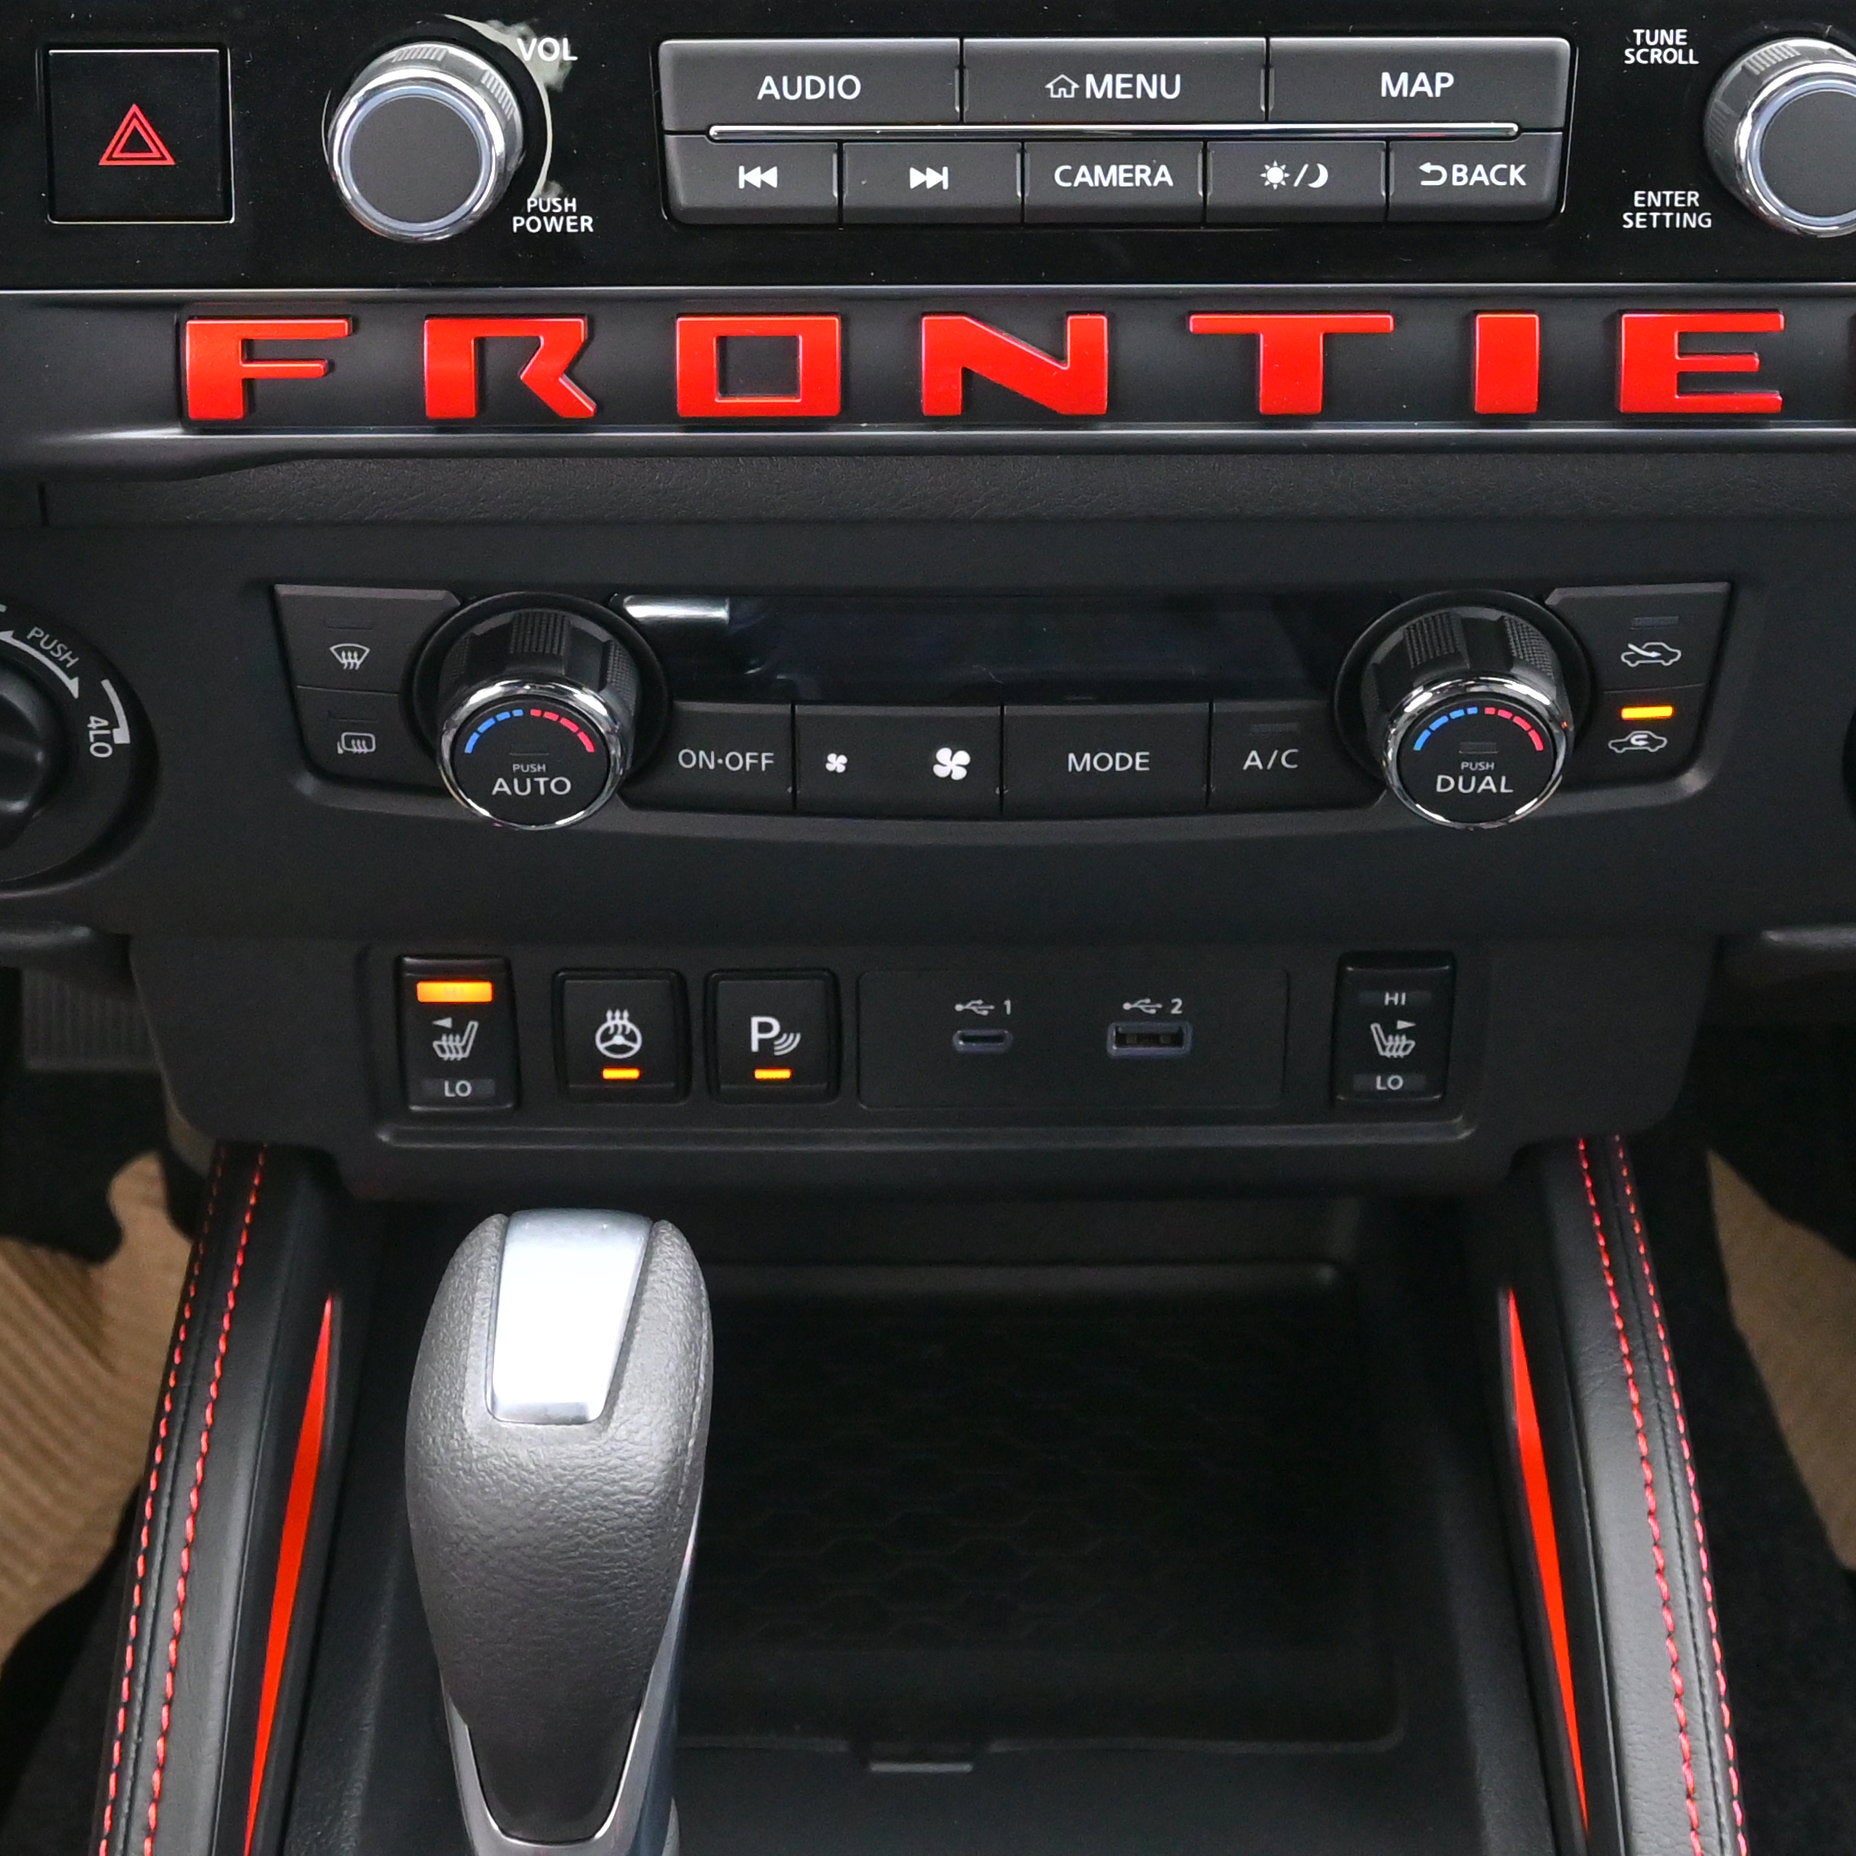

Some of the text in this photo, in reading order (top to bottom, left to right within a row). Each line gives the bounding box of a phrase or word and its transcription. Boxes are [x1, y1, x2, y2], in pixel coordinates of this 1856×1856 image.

[1632, 28, 1688, 47] TUNE
[516, 37, 578, 62] VOL
[1623, 47, 1700, 66] SCROLL
[756, 73, 863, 102] AUDIO
[1084, 73, 1182, 101] MENU
[1379, 71, 1456, 99] MAP
[1053, 164, 1174, 190] CAMERA
[1451, 162, 1528, 189] BACK
[526, 196, 578, 214] PUSH
[1632, 190, 1700, 208] ENTER
[511, 214, 595, 235] POWER
[1621, 210, 1713, 230] SETTING
[25, 626, 80, 670] PUSH
[86, 714, 115, 759] 4LO
[511, 762, 547, 774] PUSH
[1066, 751, 1151, 774] MODE
[1242, 747, 1300, 772] A/C
[1459, 760, 1495, 772] PUSH
[490, 776, 572, 797] AUTO
[1435, 774, 1515, 796] DUAL
[1003, 999, 1012, 1016] 1
[1170, 998, 1183, 1016] 2
[1383, 992, 1407, 1006] HI
[749, 1015, 780, 1053] P
[443, 1080, 473, 1098] LO
[1375, 1074, 1404, 1091] LO
